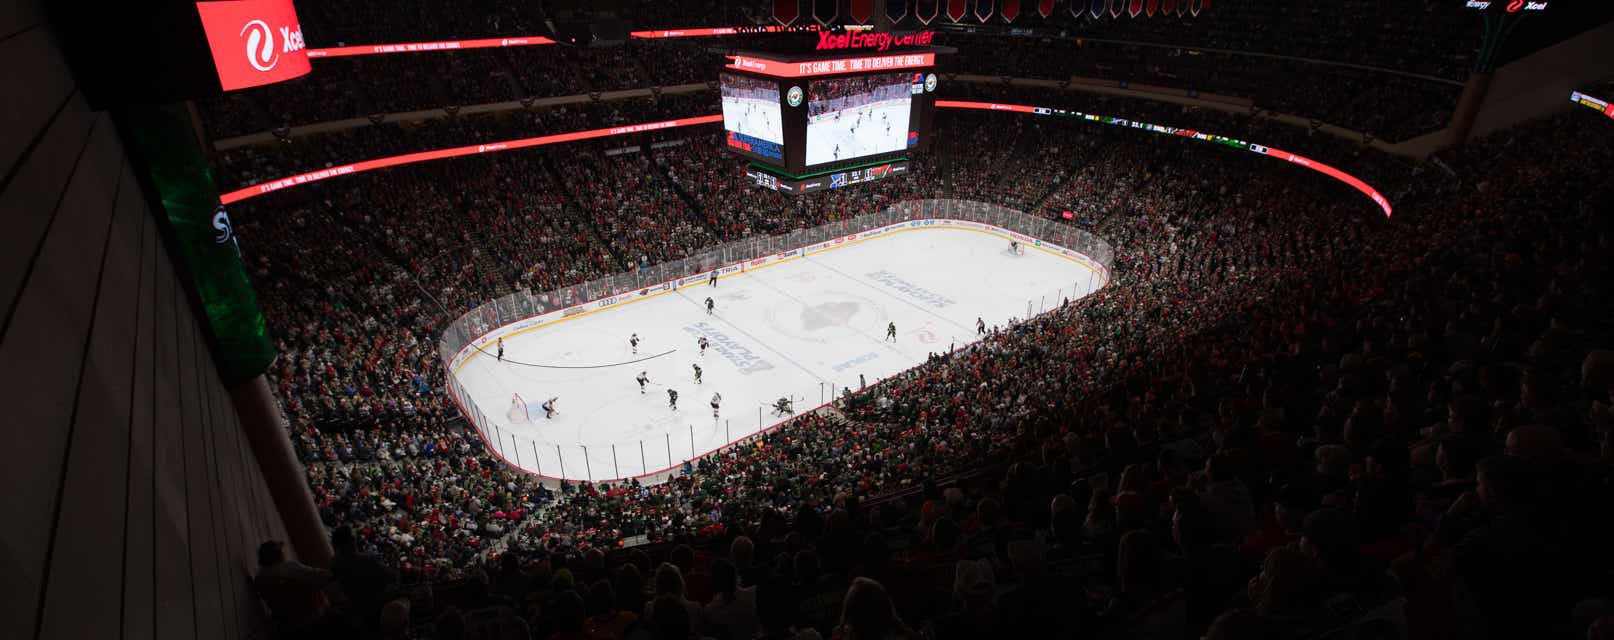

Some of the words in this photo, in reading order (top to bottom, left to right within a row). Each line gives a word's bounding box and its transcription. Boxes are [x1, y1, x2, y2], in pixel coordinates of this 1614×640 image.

[816, 29, 851, 50] Xcel
[851, 30, 893, 51] Energy
[800, 62, 812, 74] IT'S
[813, 61, 831, 73] GAME
[850, 59, 864, 70] TIME
[864, 58, 872, 69] TO
[872, 56, 894, 69] DELIVER
[894, 56, 904, 67] THE
[722, 266, 738, 274] TRIA
